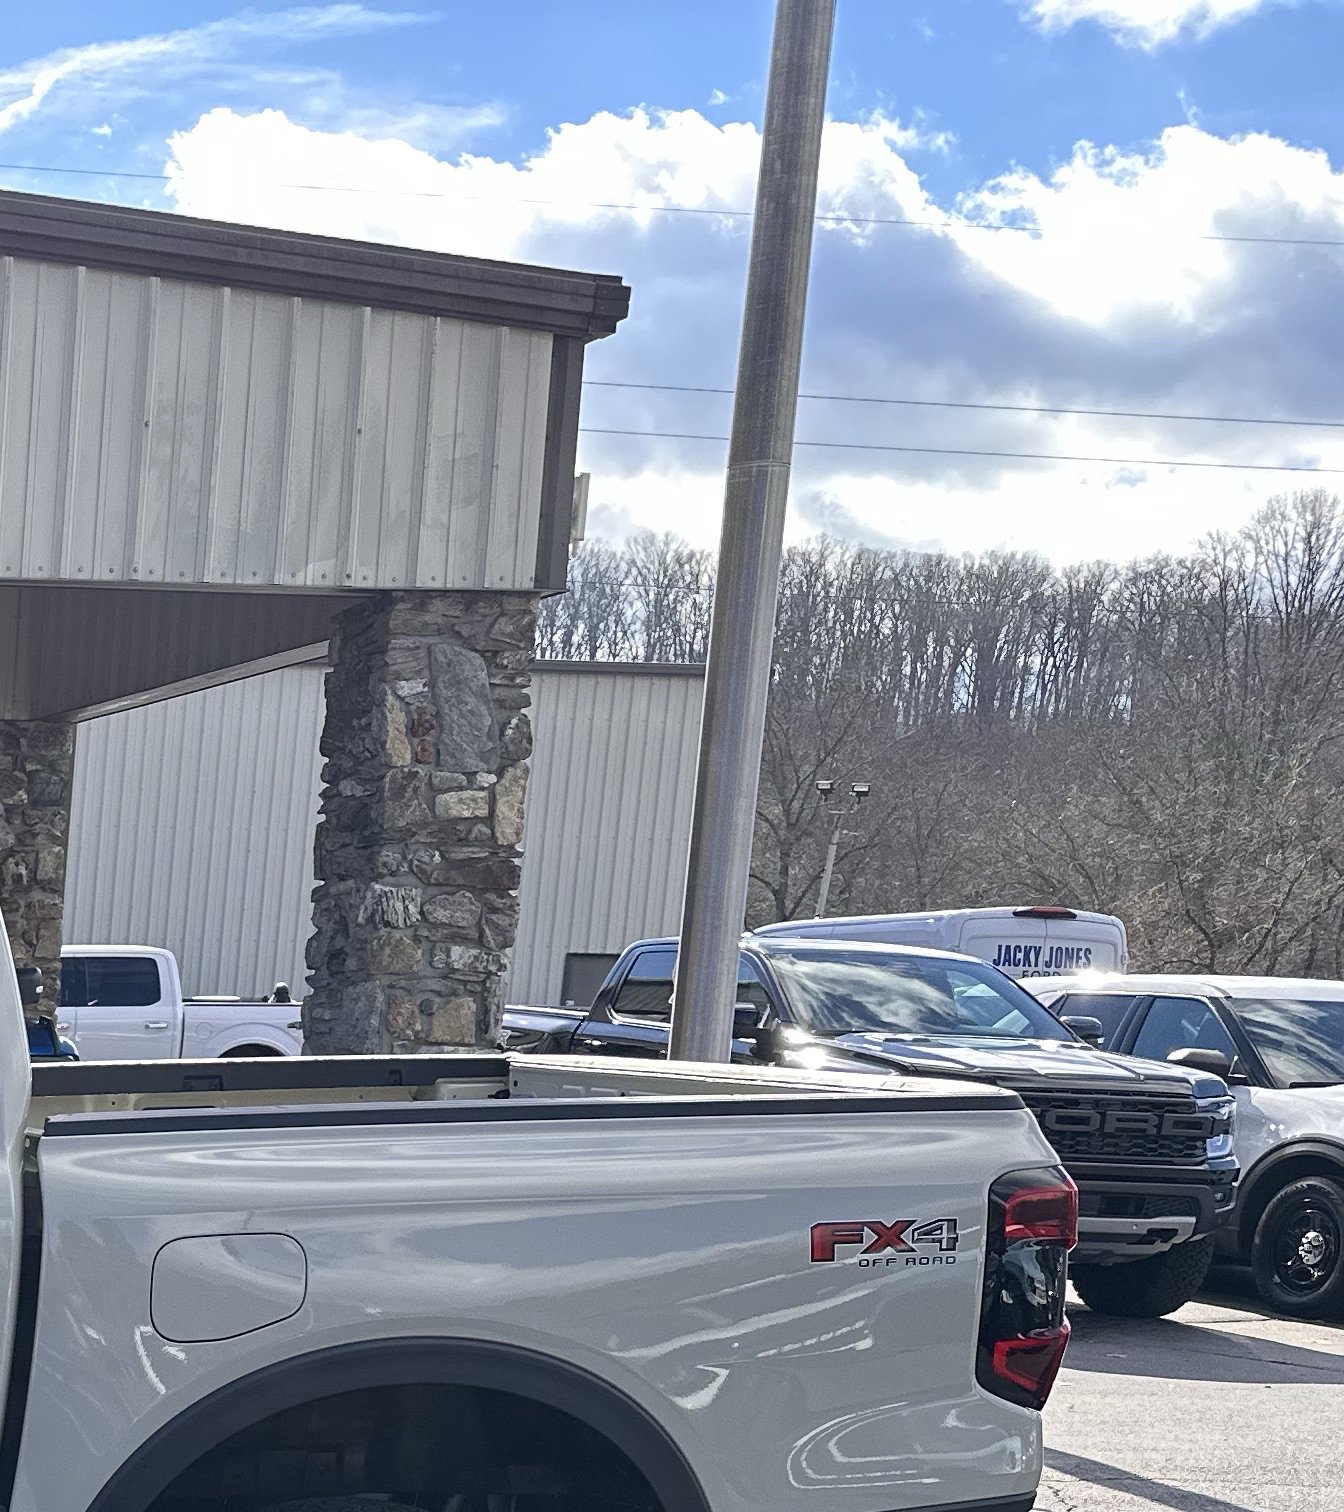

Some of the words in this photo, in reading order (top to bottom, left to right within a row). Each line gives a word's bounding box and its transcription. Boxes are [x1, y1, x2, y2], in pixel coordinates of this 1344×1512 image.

[993, 944, 1042, 967] JACKY
[1045, 946, 1092, 969] JONES
[1036, 1108, 1213, 1136] ORD
[809, 1216, 960, 1264] FX4
[858, 1257, 897, 1268] OFF
[905, 1255, 957, 1266] ROAD
